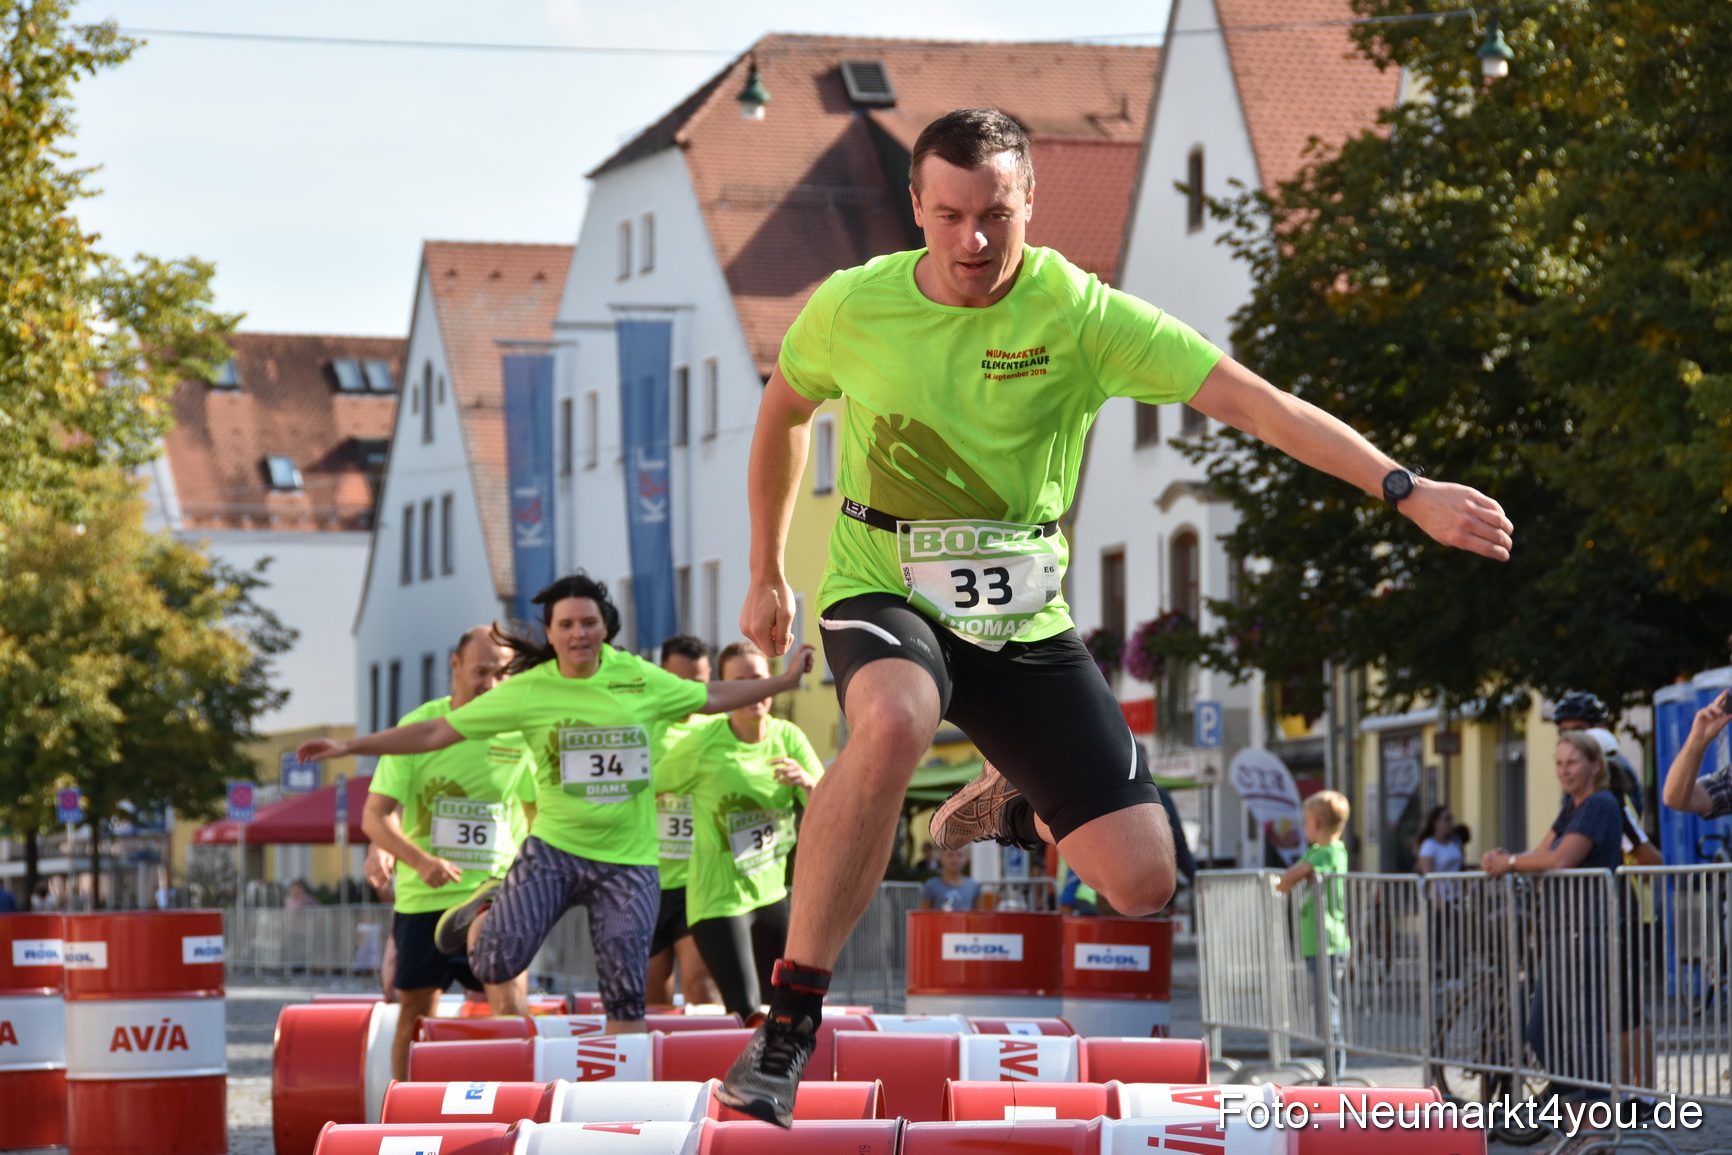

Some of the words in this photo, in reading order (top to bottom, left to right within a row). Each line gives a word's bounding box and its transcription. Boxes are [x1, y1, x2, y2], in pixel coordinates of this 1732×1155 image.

[1030, 368, 1047, 376] 2019
[950, 566, 1013, 608] 33
[566, 728, 642, 748] BOCK
[589, 754, 624, 777] 34
[586, 784, 628, 796] DIANA
[456, 824, 487, 846] 36
[667, 817, 694, 837] 35
[750, 825, 773, 850] 39
